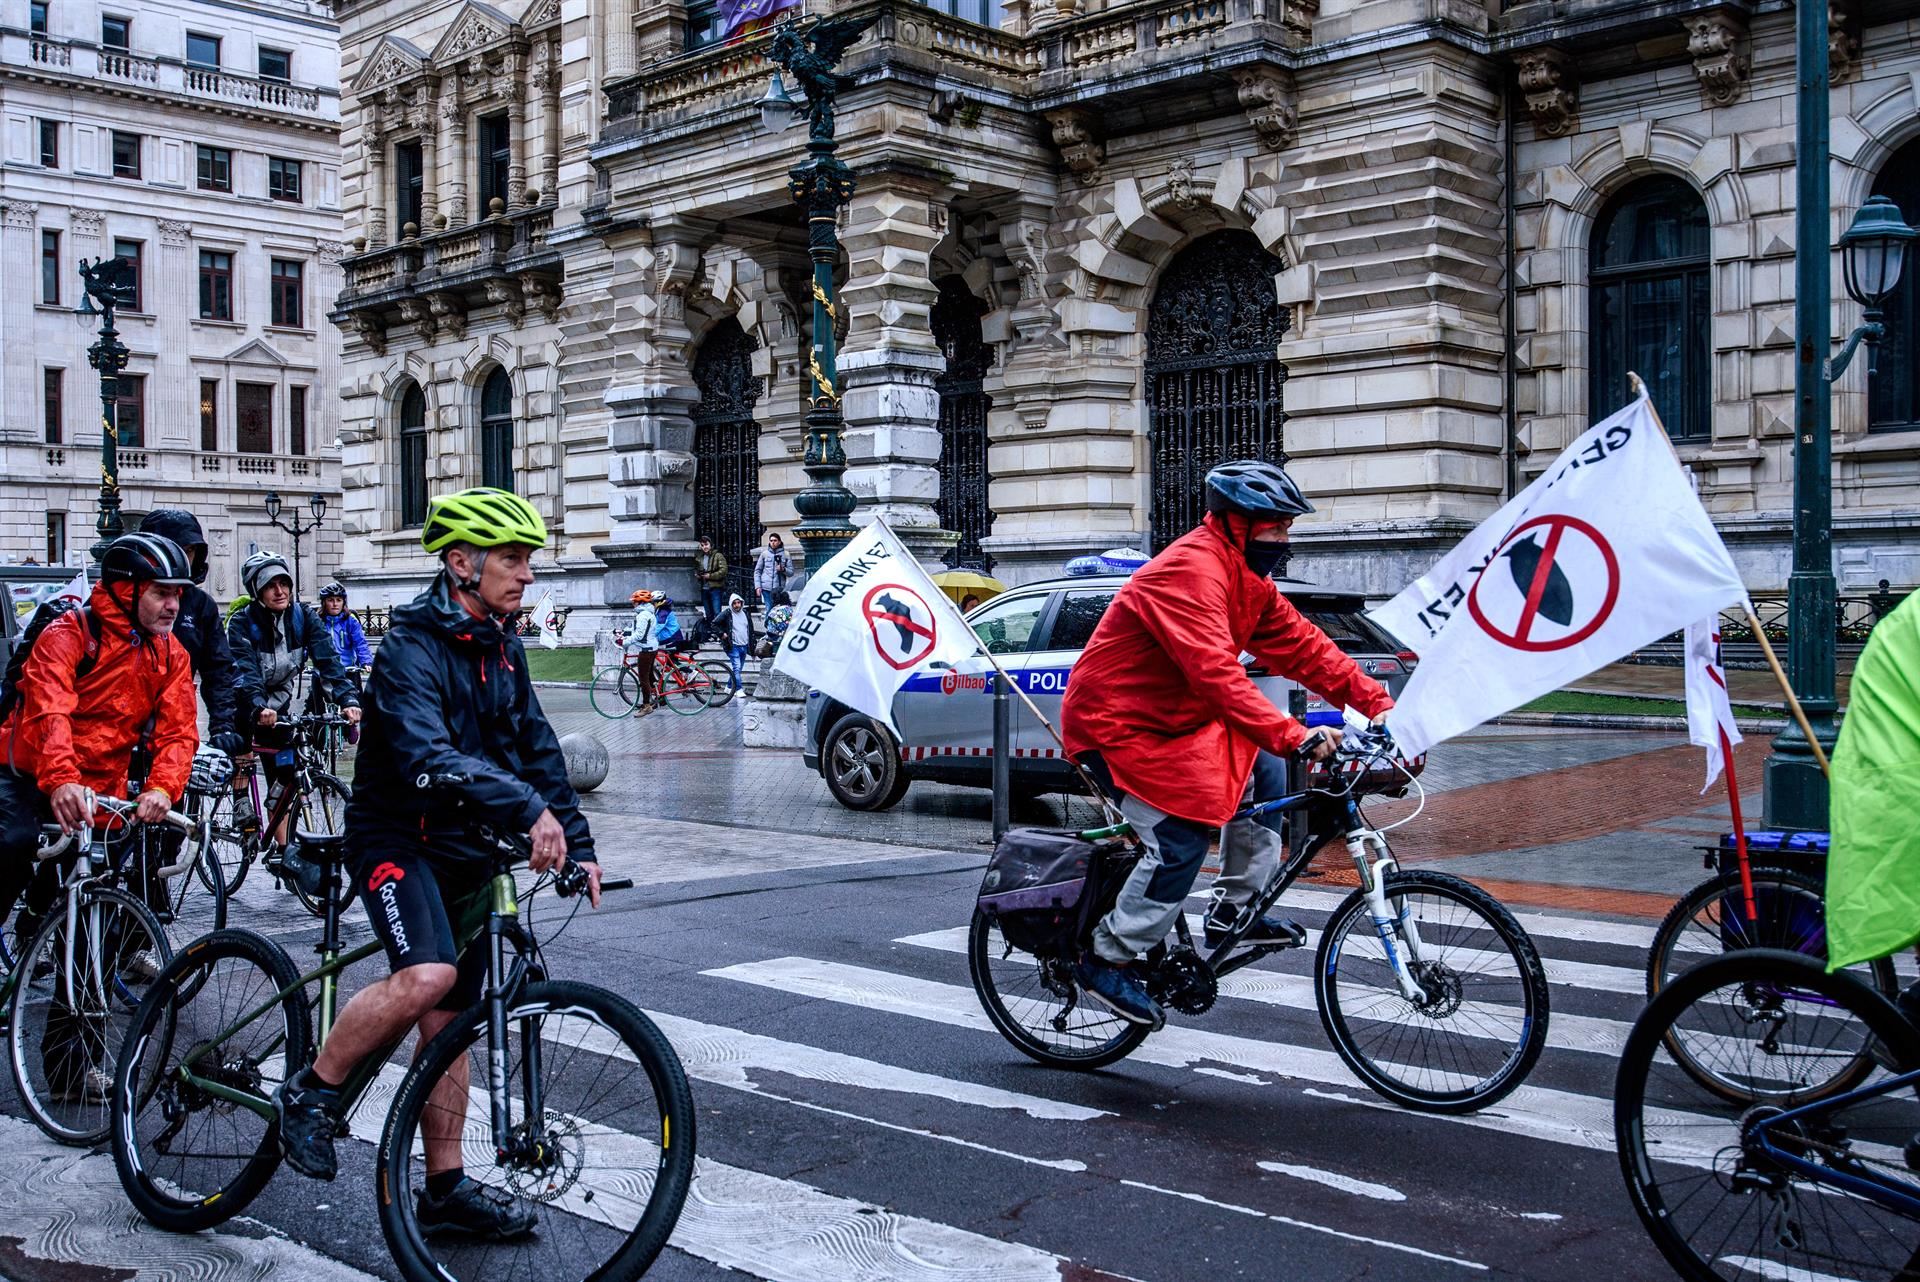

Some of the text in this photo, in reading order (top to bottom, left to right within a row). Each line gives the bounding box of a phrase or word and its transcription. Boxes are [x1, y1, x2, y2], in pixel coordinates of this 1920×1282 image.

[788, 558, 877, 653] GERRARIK
[945, 673, 985, 690] Bilbao
[1029, 672, 1071, 690] POL
[390, 921, 411, 955] sport
[491, 1049, 506, 1112] FOX
